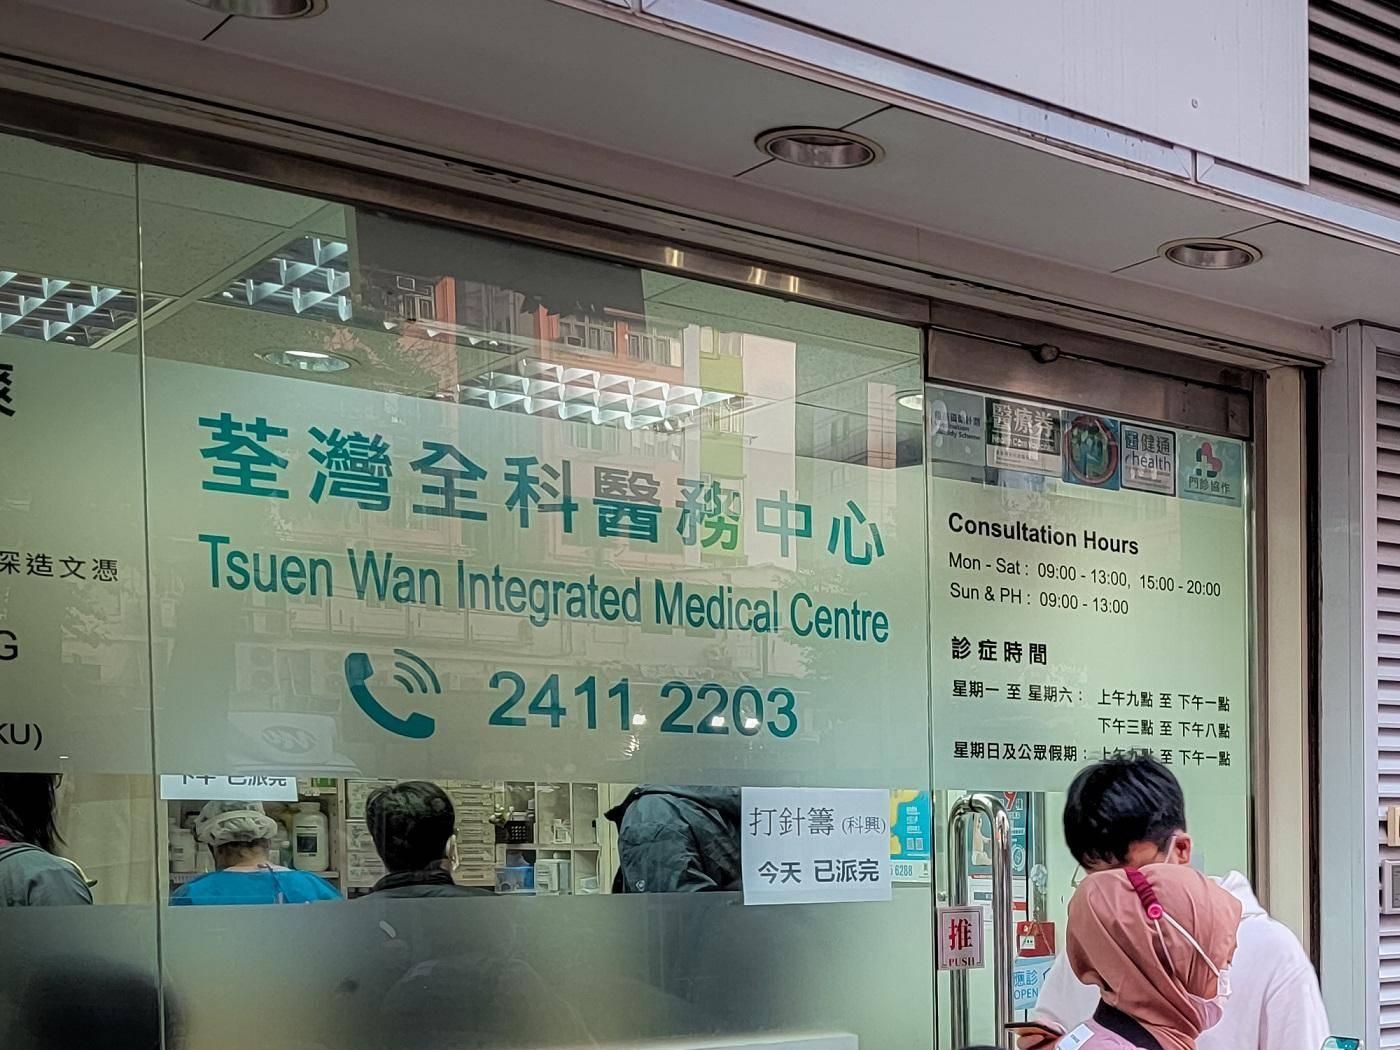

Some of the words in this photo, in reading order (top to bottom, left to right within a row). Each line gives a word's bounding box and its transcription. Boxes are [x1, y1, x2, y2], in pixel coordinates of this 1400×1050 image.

[198, 411, 886, 567] 荃灣全科醫務中心
[1188, 475, 1231, 494] 門診協作
[949, 512, 1077, 548] Consultation
[1084, 530, 1139, 555] Hours
[199, 534, 333, 597] Tsuen
[347, 549, 441, 607] Wan
[457, 558, 643, 628] Integrated
[655, 578, 779, 634] Medical
[791, 592, 889, 644] Centre
[949, 552, 981, 571] Mon
[1038, 562, 1076, 581] 09:00
[1140, 575, 1174, 592] 15:00
[1187, 579, 1221, 597] 20:00
[950, 582, 979, 600] Sun
[1040, 591, 1078, 610] 09:00
[1094, 597, 1129, 614] 13:00
[951, 636, 1048, 665] 診症時間
[488, 669, 630, 730] 2411
[659, 684, 798, 738] 2203
[952, 679, 999, 698] 星期一
[1006, 683, 1021, 700] 至
[1098, 688, 1153, 708] 上午九點
[1178, 694, 1230, 712] 下午一點
[1098, 718, 1153, 736] 下午三點
[1178, 721, 1230, 739] 下午八點
[1179, 749, 1230, 766] 下午一點
[749, 806, 835, 837] 打針籌
[758, 860, 802, 884] 今天
[813, 858, 880, 883] 已派完
[948, 918, 973, 951] 推
[948, 956, 975, 967] PUSH
[1013, 987, 1039, 1000] OPEN
